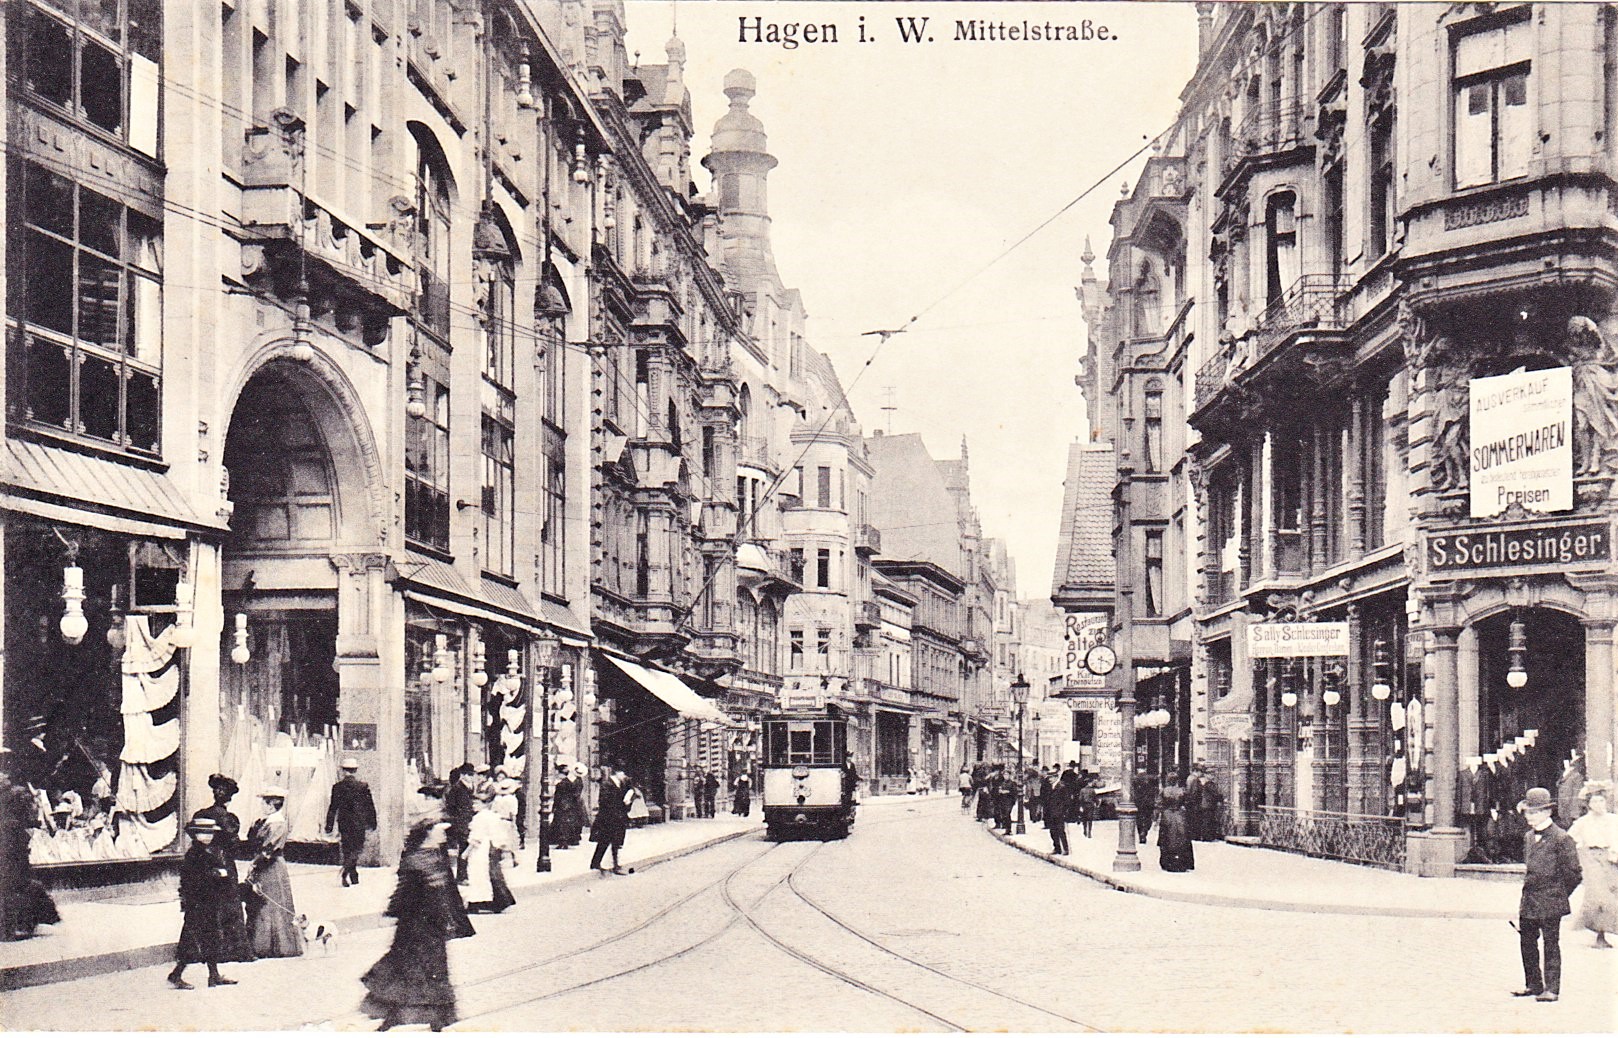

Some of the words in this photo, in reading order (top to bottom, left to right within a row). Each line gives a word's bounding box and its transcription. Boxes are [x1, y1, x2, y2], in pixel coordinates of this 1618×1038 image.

[1476, 378, 1548, 412] AUSVERKAUF
[1473, 421, 1565, 472] SOMMERWAREN
[1498, 485, 1550, 505] Preisen
[1064, 615, 1107, 640] Restaurant
[1253, 626, 1280, 642] Sally
[1282, 623, 1341, 644] Schlesinger
[1067, 698, 1103, 708] Chemische
